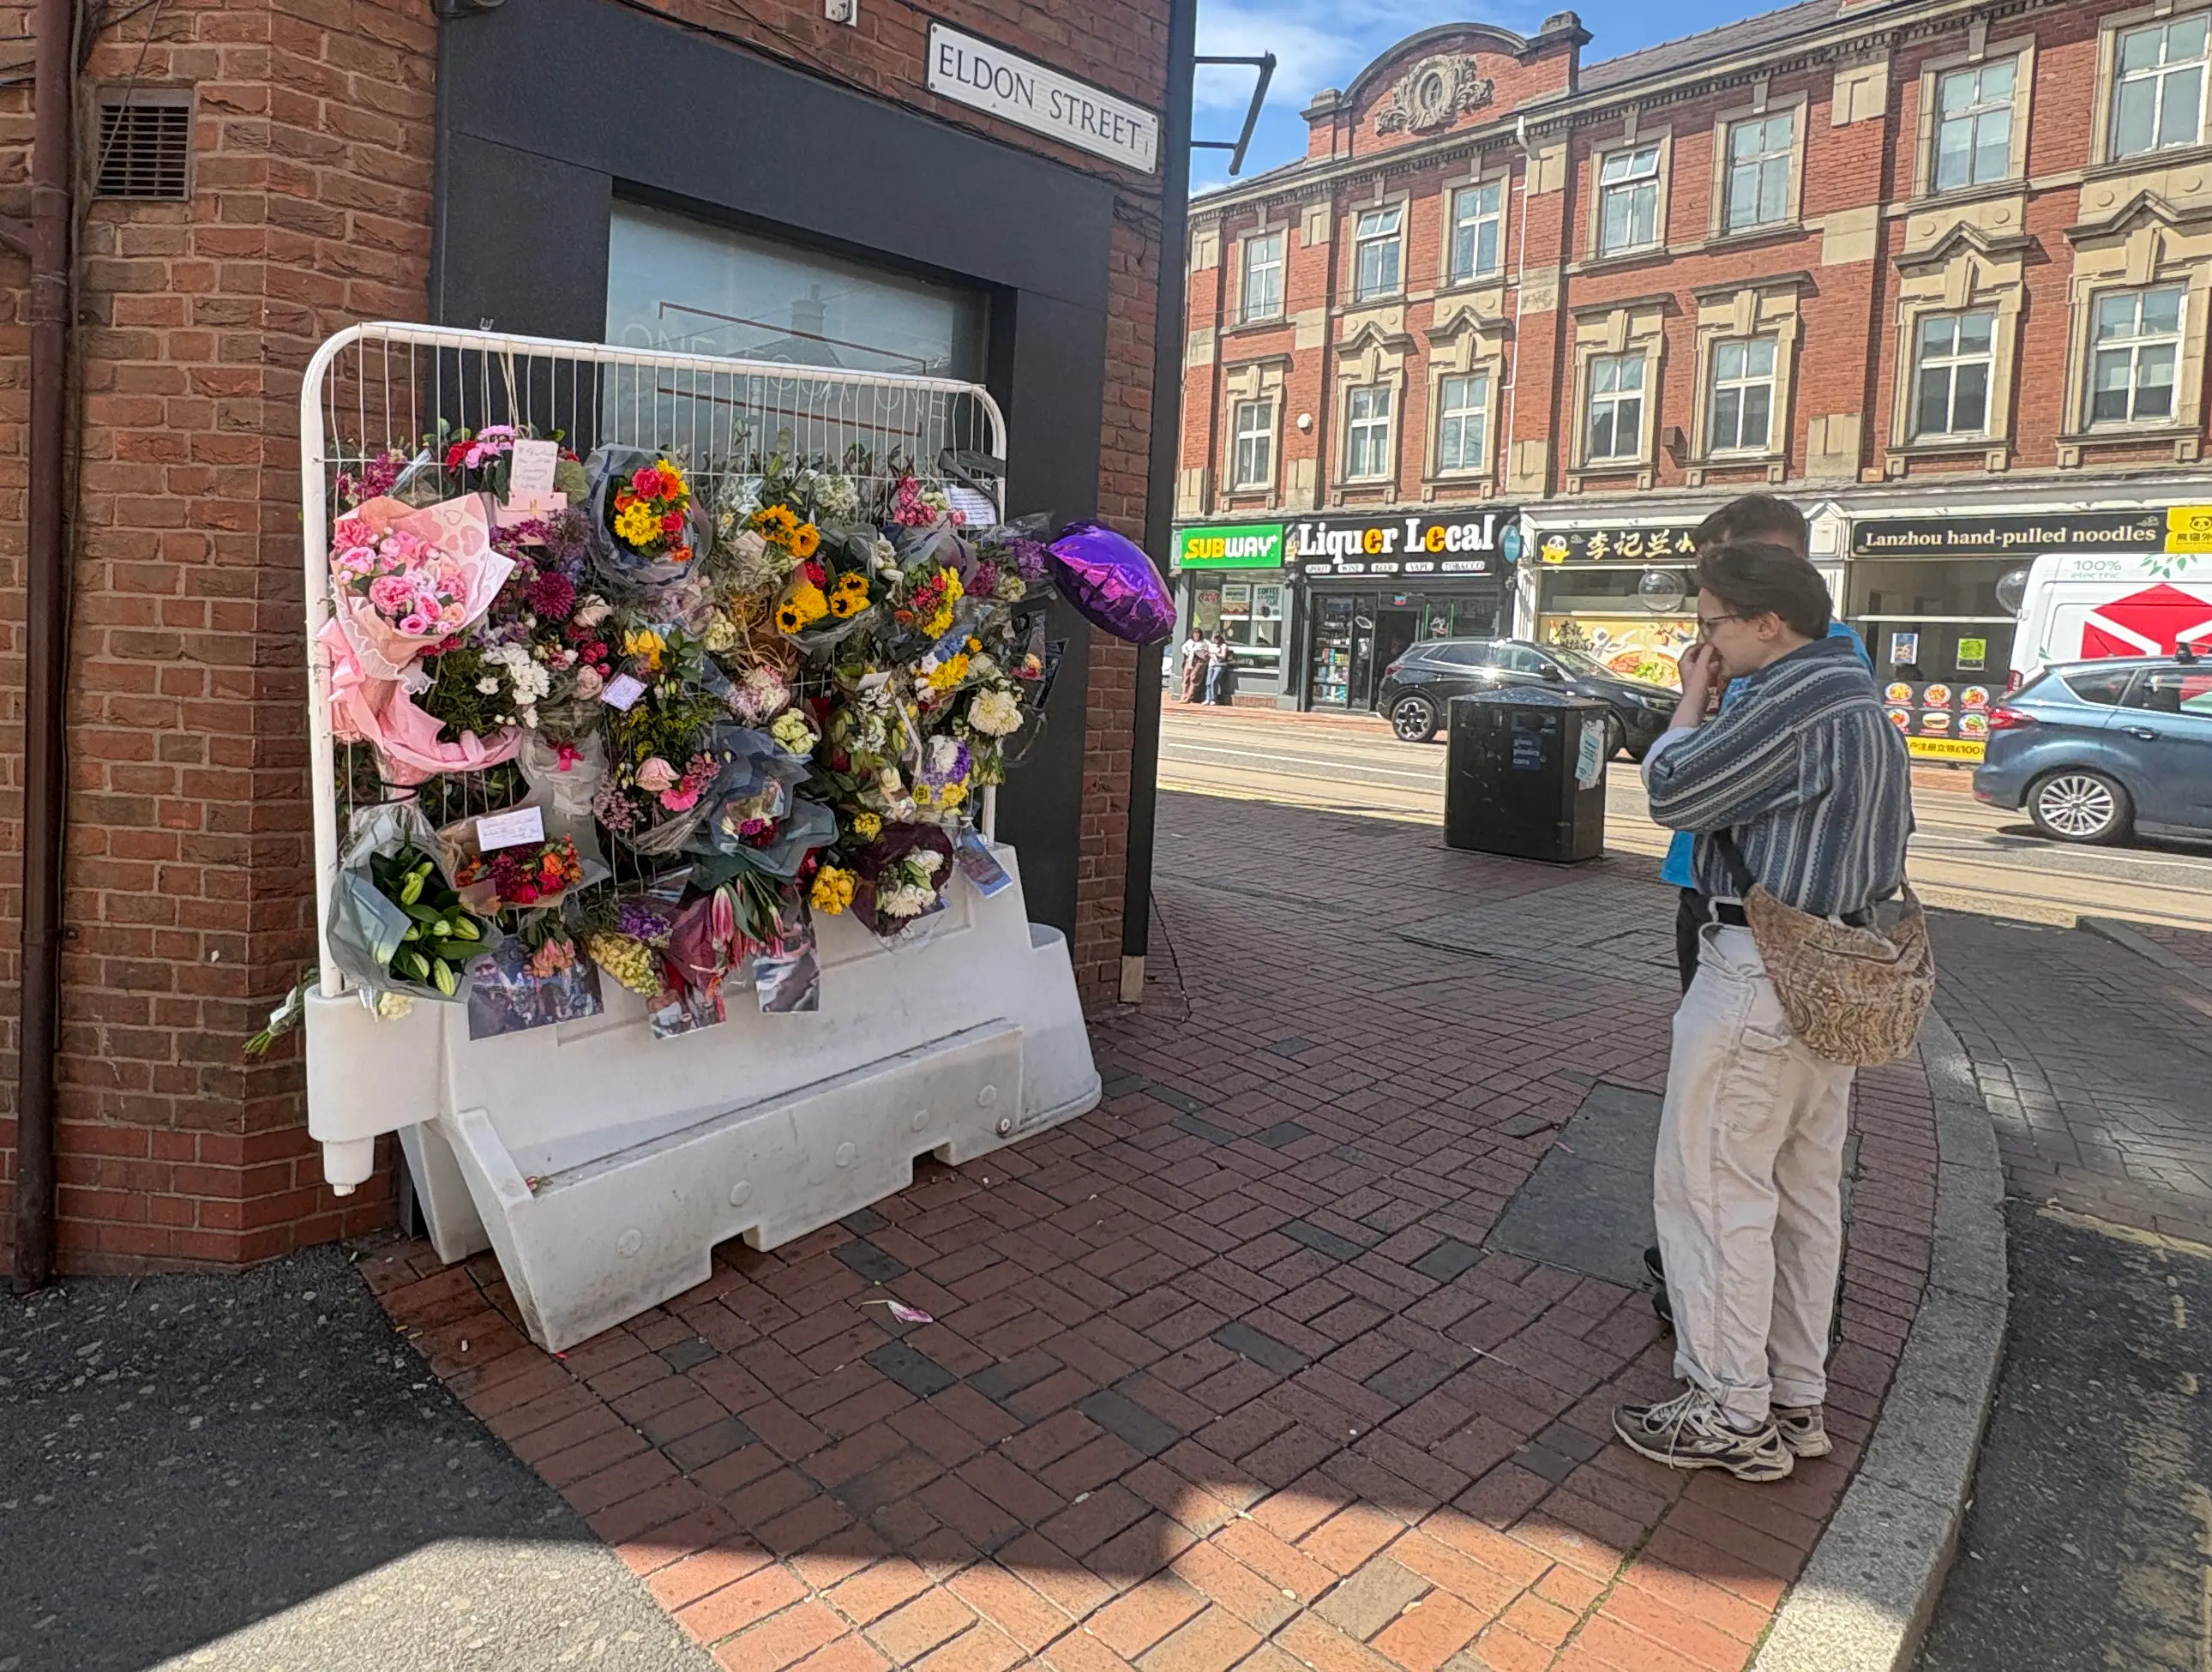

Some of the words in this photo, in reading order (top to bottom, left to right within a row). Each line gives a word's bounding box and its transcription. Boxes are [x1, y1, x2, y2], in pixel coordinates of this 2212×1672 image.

[938, 42, 1035, 110] ELDON
[1049, 88, 1142, 151] STREET
[1866, 530, 1943, 546] Lanzhou
[1947, 526, 2067, 548] hand-pulled
[2071, 525, 2157, 543] noodles
[1184, 533, 1278, 561] SUBWAY
[1410, 562, 1429, 571] VAPE
[1445, 561, 1483, 570] TOBACCO
[2073, 559, 2123, 571] 100%
[2071, 571, 2121, 580] electric
